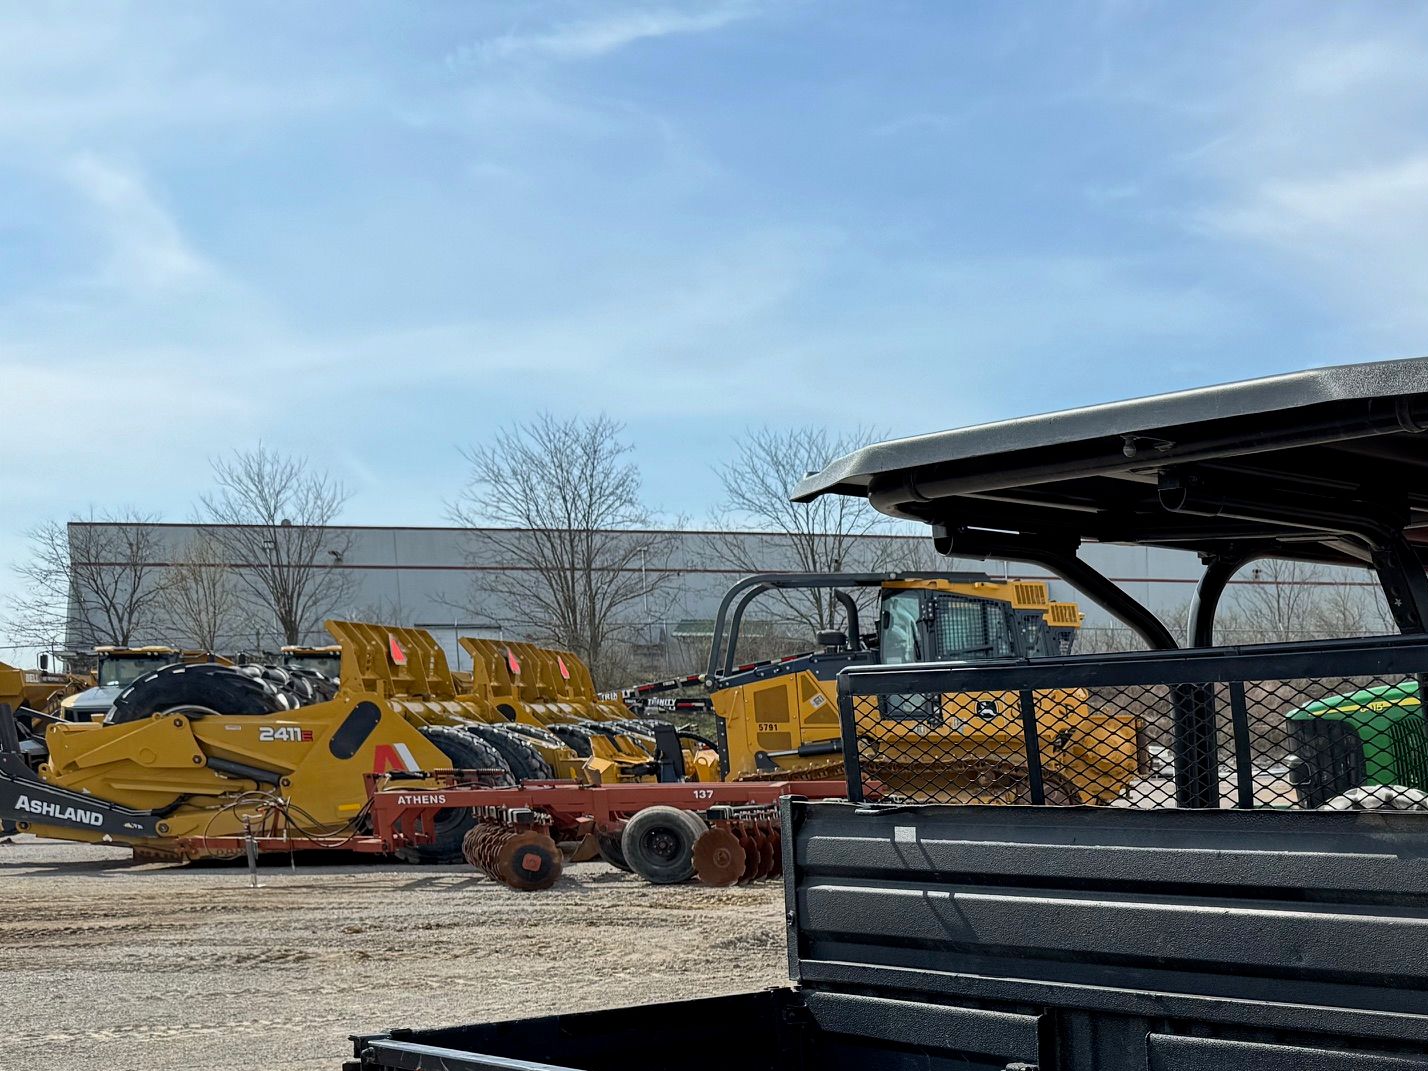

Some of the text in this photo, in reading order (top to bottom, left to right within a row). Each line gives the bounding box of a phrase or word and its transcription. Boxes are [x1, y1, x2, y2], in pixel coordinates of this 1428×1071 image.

[693, 790, 714, 799] 137
[397, 795, 446, 805] ATHENS
[15, 795, 103, 826] ASHLAND
